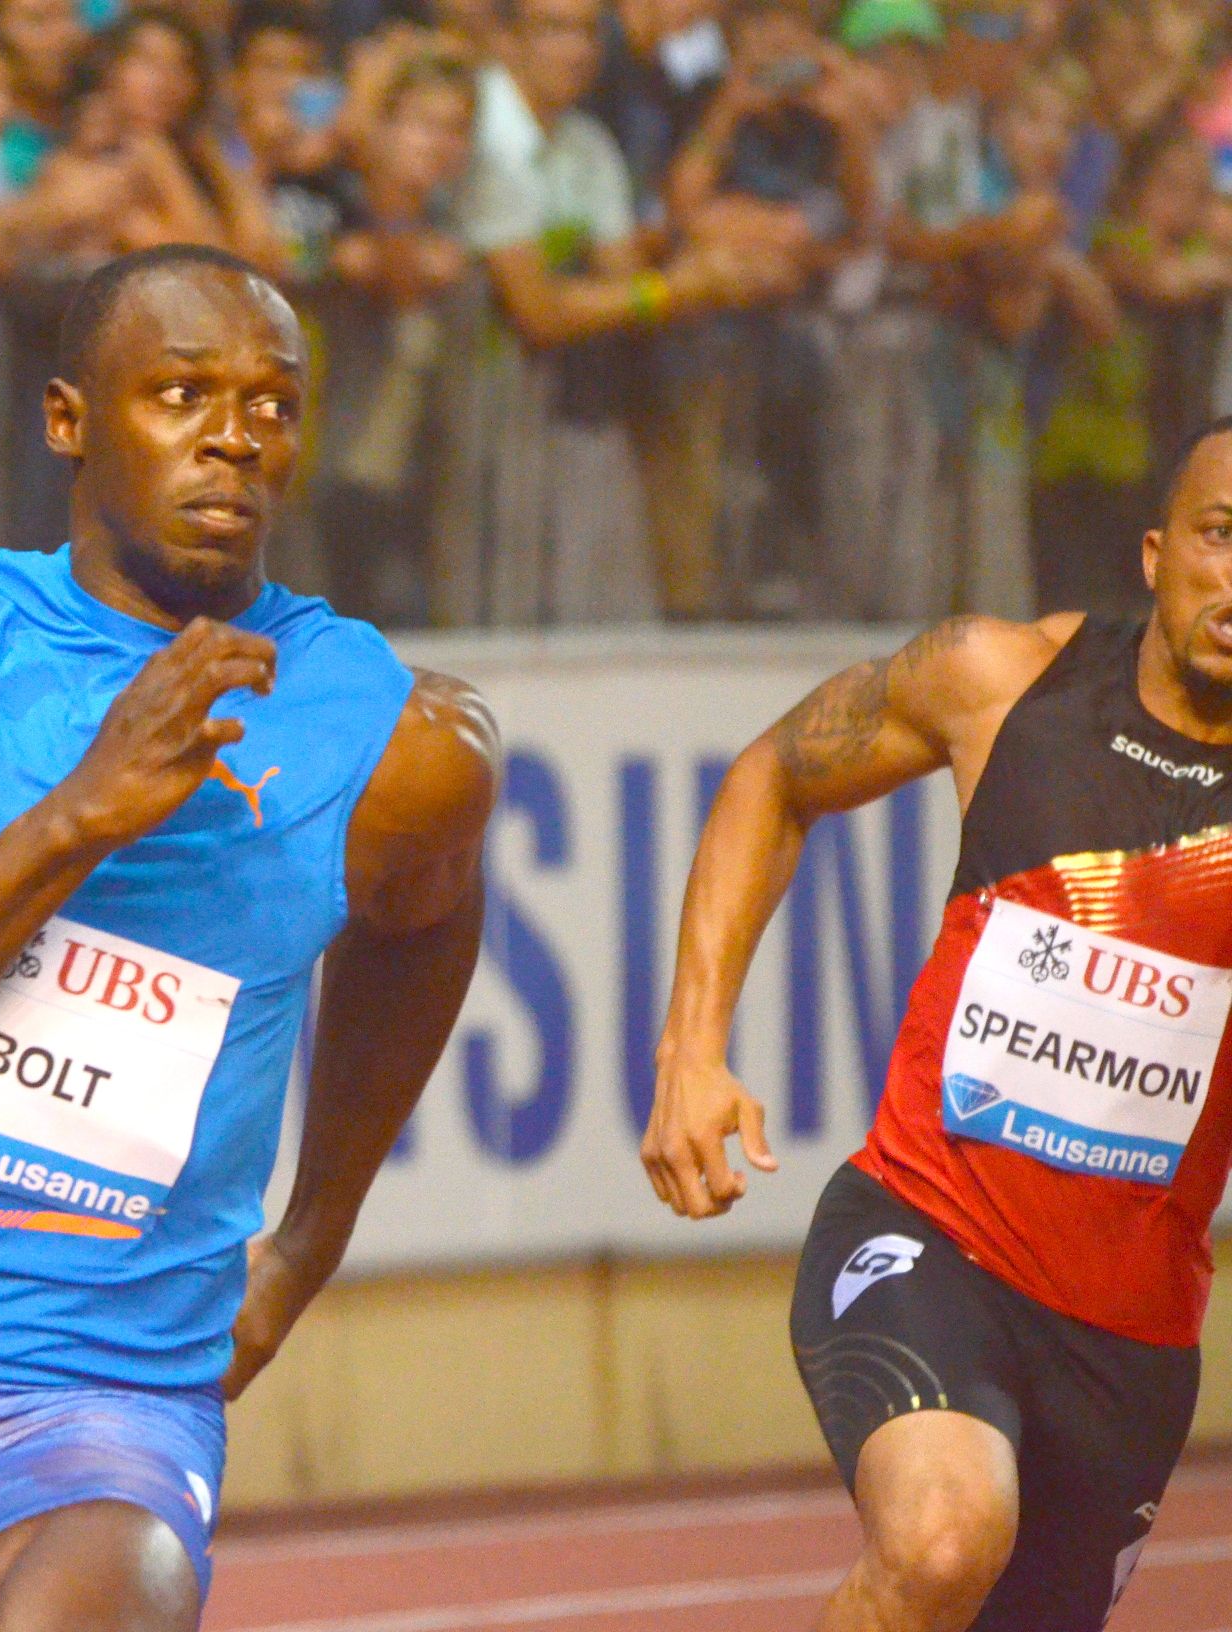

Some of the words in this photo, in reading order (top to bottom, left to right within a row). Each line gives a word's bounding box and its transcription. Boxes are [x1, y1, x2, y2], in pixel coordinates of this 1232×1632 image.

[1110, 734, 1224, 787] saucony
[56, 939, 182, 1024] UBS
[1082, 946, 1195, 1018] UBS
[959, 1002, 1202, 1105] SPEARMON
[1000, 1109, 1170, 1178] Lausanne
